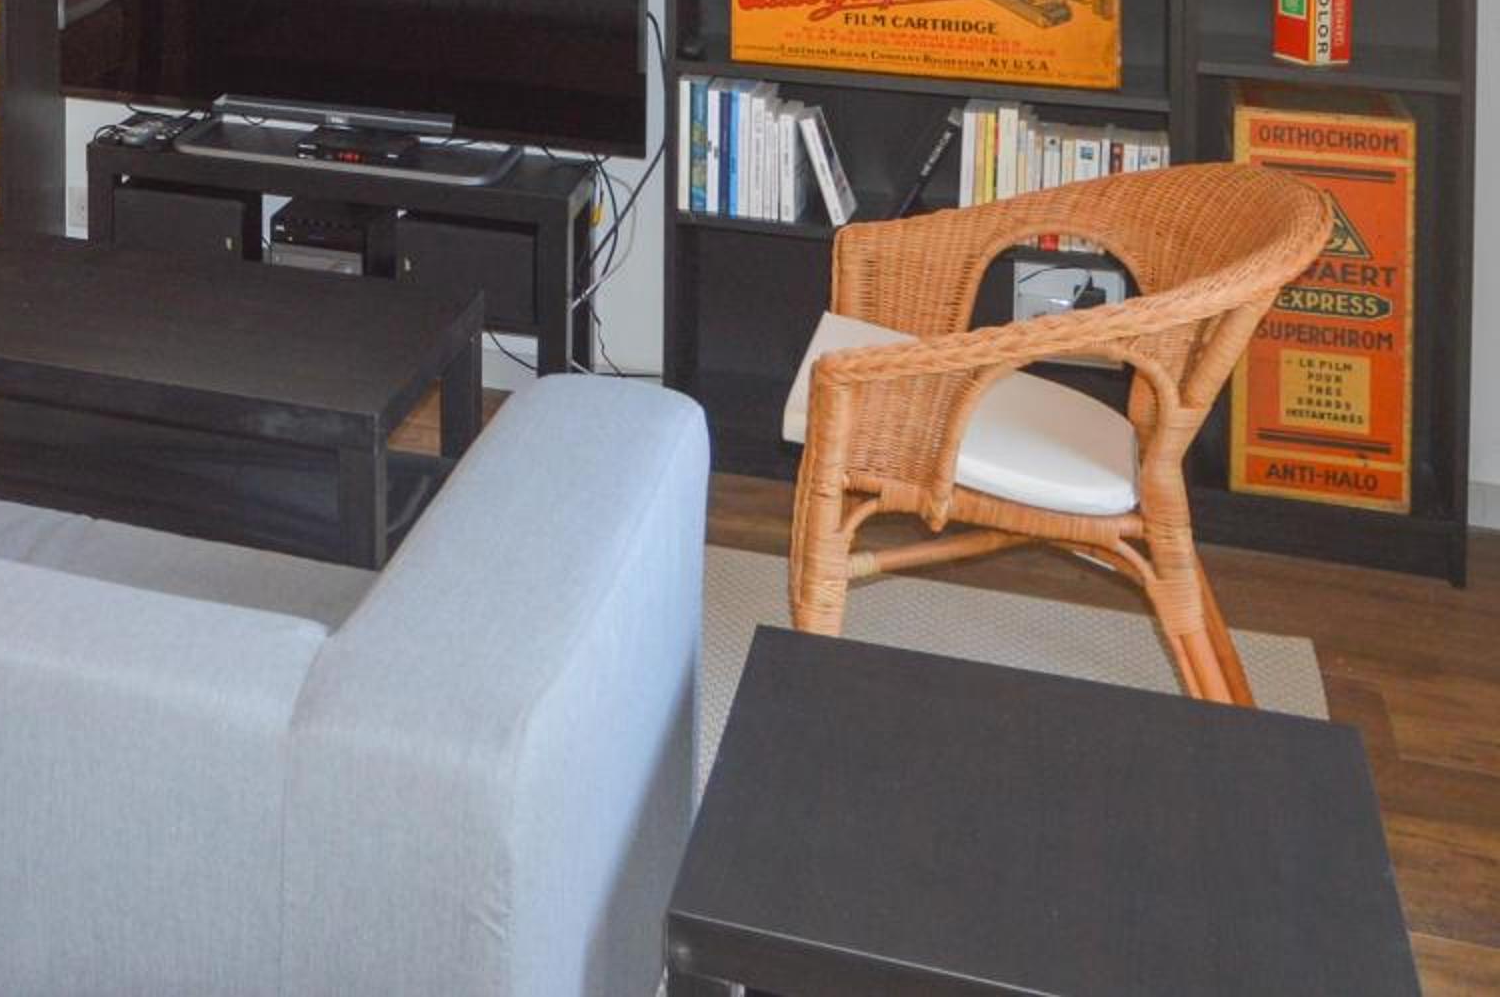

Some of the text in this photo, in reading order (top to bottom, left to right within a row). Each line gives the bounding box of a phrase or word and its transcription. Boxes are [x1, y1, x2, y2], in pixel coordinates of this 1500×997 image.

[843, 12, 997, 35] FILM CARTRIDGE
[1259, 123, 1399, 152] ORTHOCHROM
[1276, 290, 1380, 317] EXPRESS
[1256, 319, 1394, 351] SUPERCHROM
[1319, 361, 1353, 372] FILM
[1265, 462, 1379, 492] ANTI-HALO
